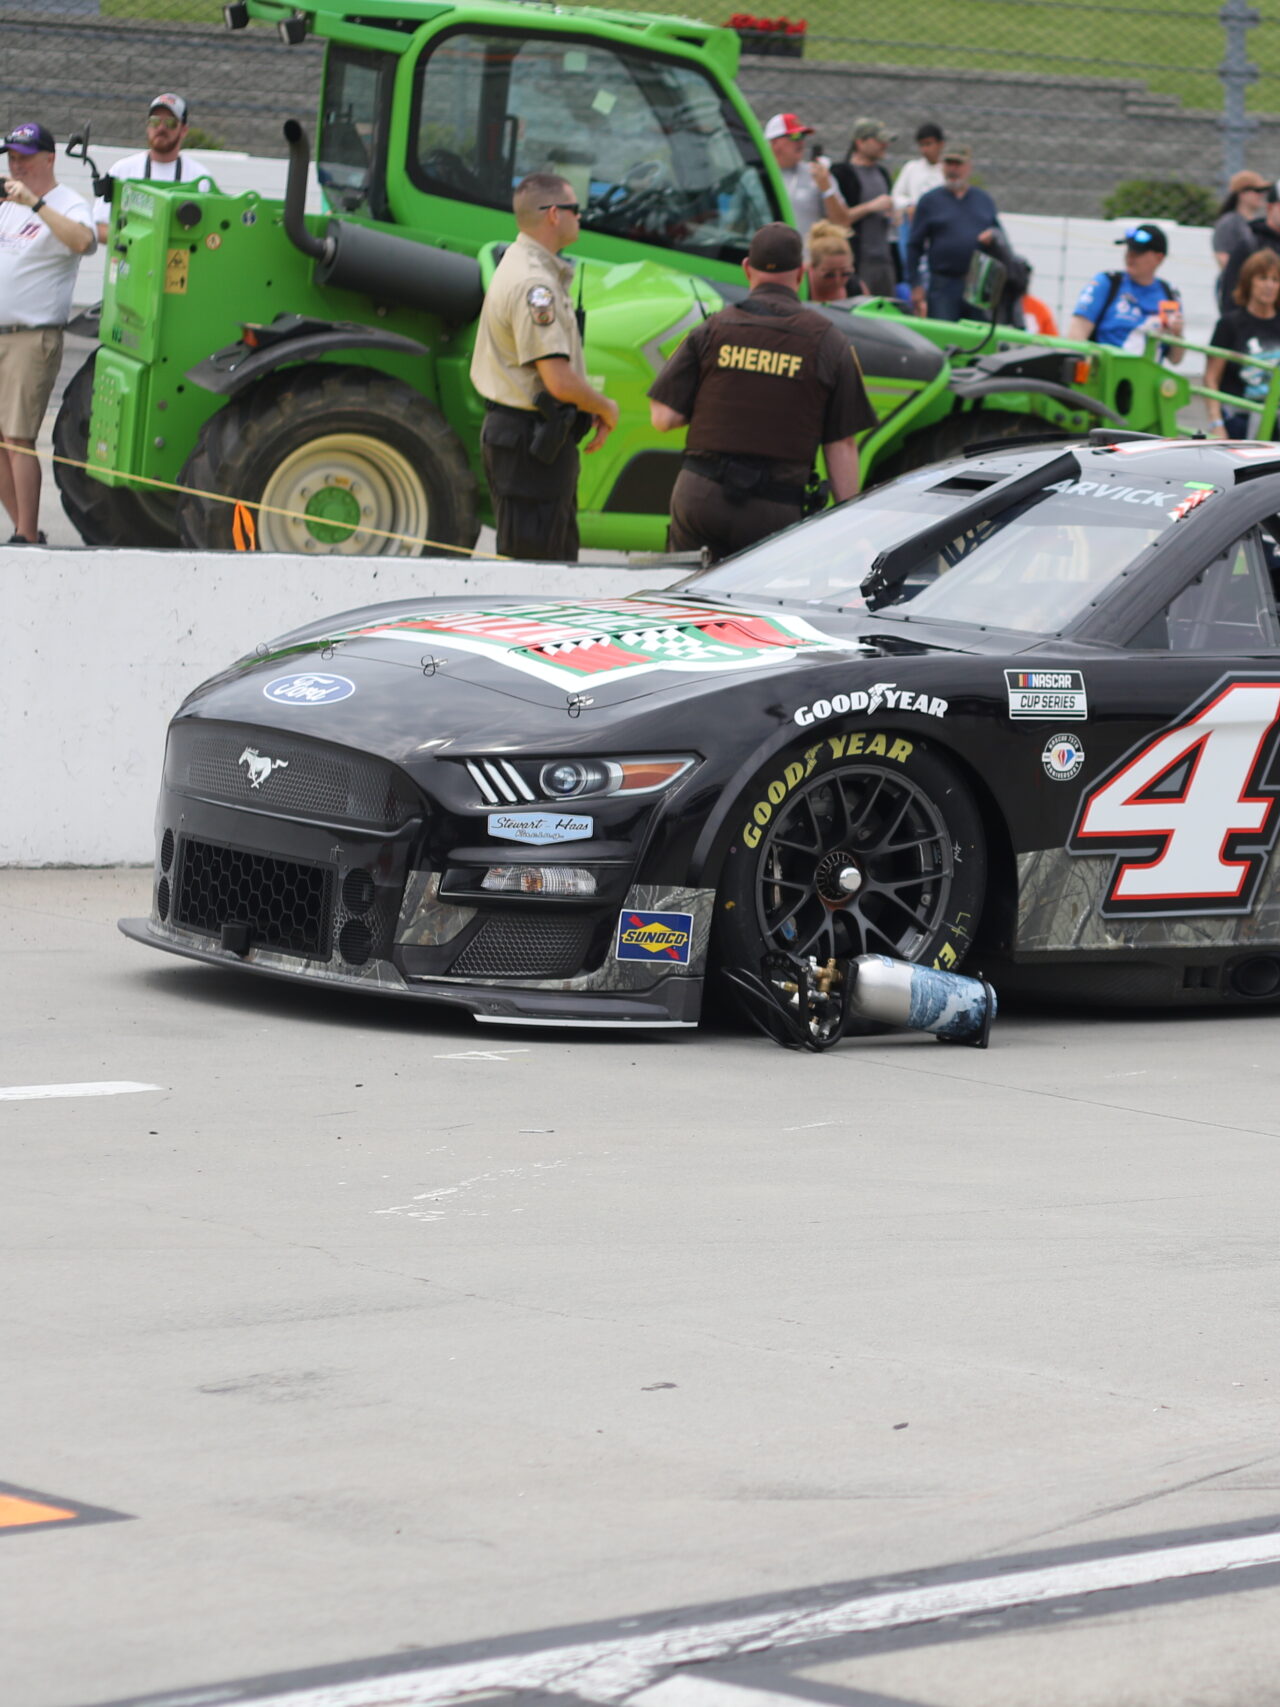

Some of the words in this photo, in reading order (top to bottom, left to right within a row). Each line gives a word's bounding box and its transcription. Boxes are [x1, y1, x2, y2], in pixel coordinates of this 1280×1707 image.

[717, 344, 803, 378] SHERIFF
[1042, 479, 1178, 508] ARVICK
[269, 674, 347, 702] Ford
[1031, 673, 1073, 688] NASCAR
[1020, 694, 1042, 709] CUP
[1041, 695, 1076, 709] SERIES
[491, 816, 546, 829] Stewart
[555, 818, 589, 831] Haas
[624, 930, 686, 945] SUNOCO
